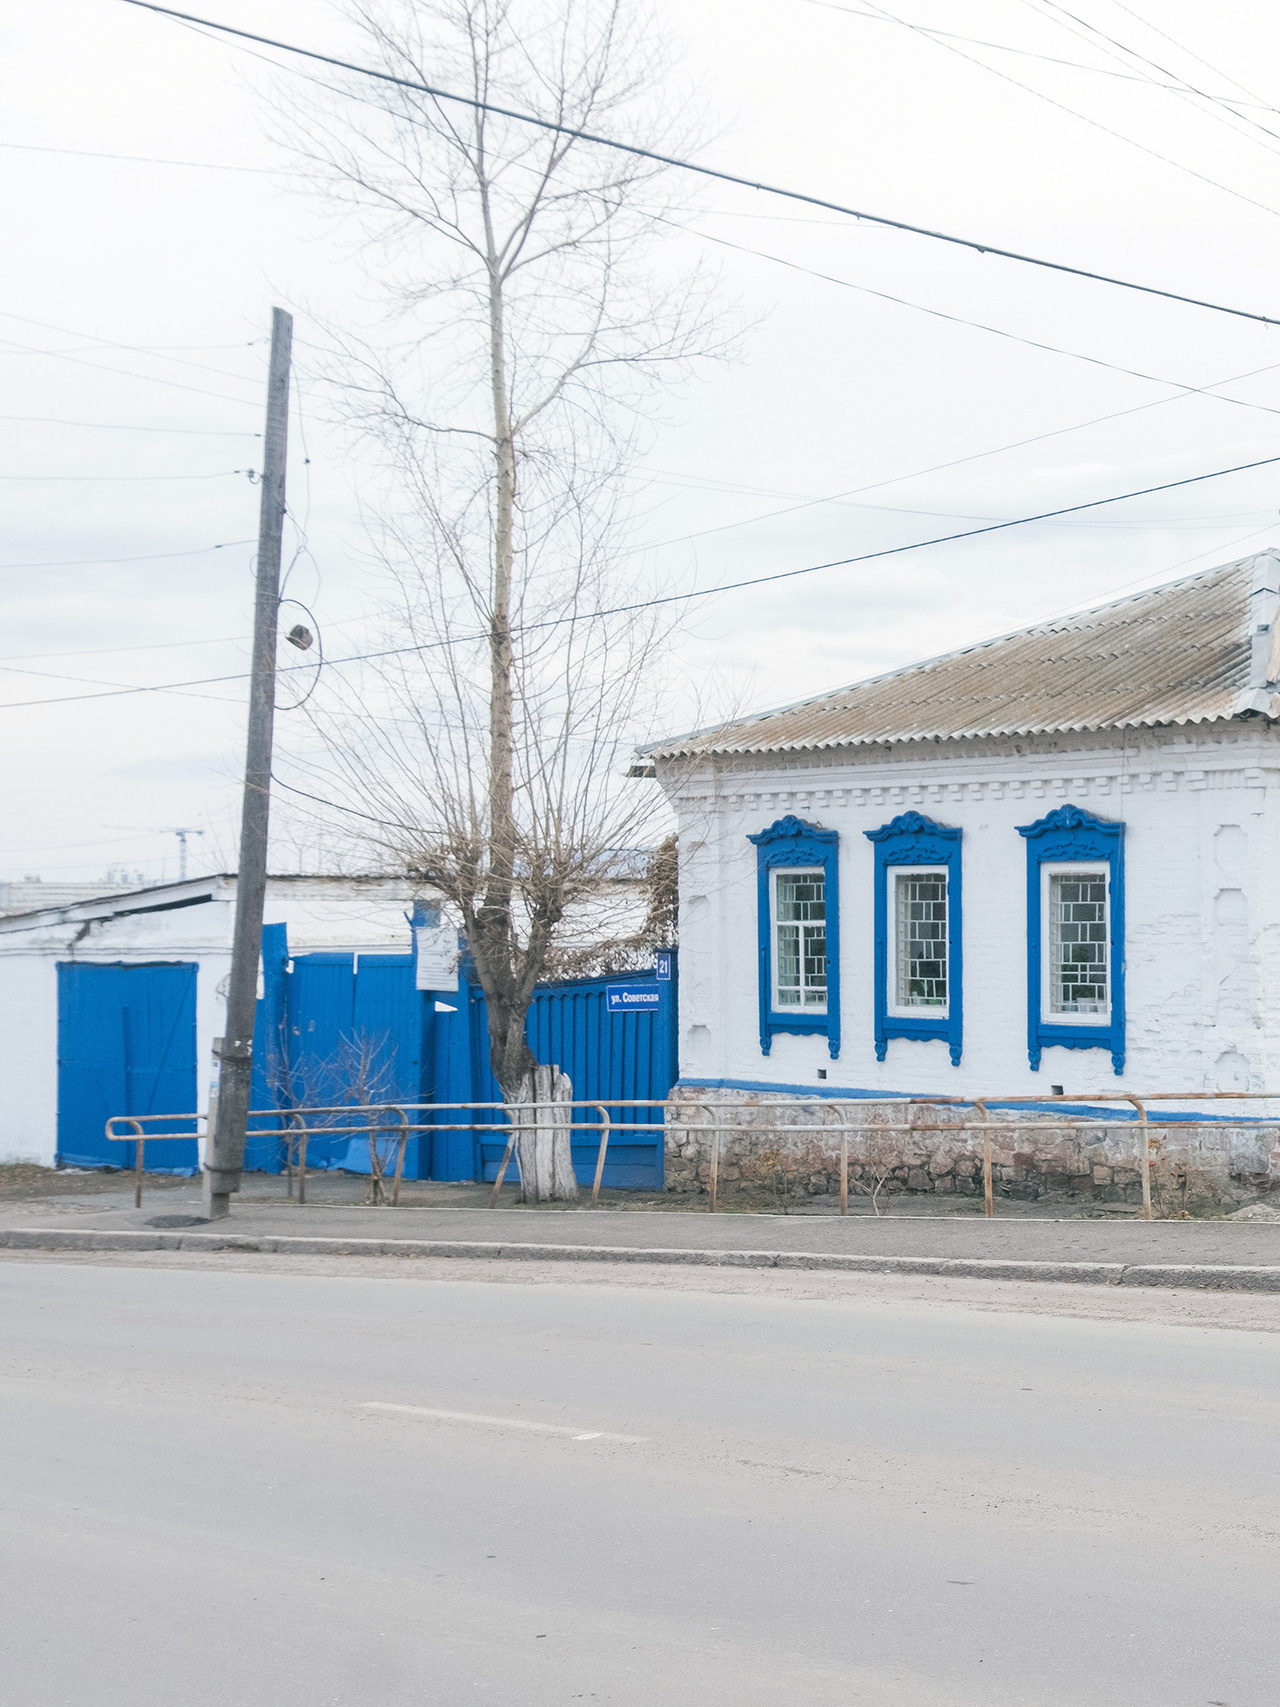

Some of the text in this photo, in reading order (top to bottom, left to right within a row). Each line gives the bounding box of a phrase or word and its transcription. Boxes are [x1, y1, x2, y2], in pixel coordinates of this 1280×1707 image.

[659, 960, 668, 973] 21
[611, 992, 659, 1005] ул. Советская
